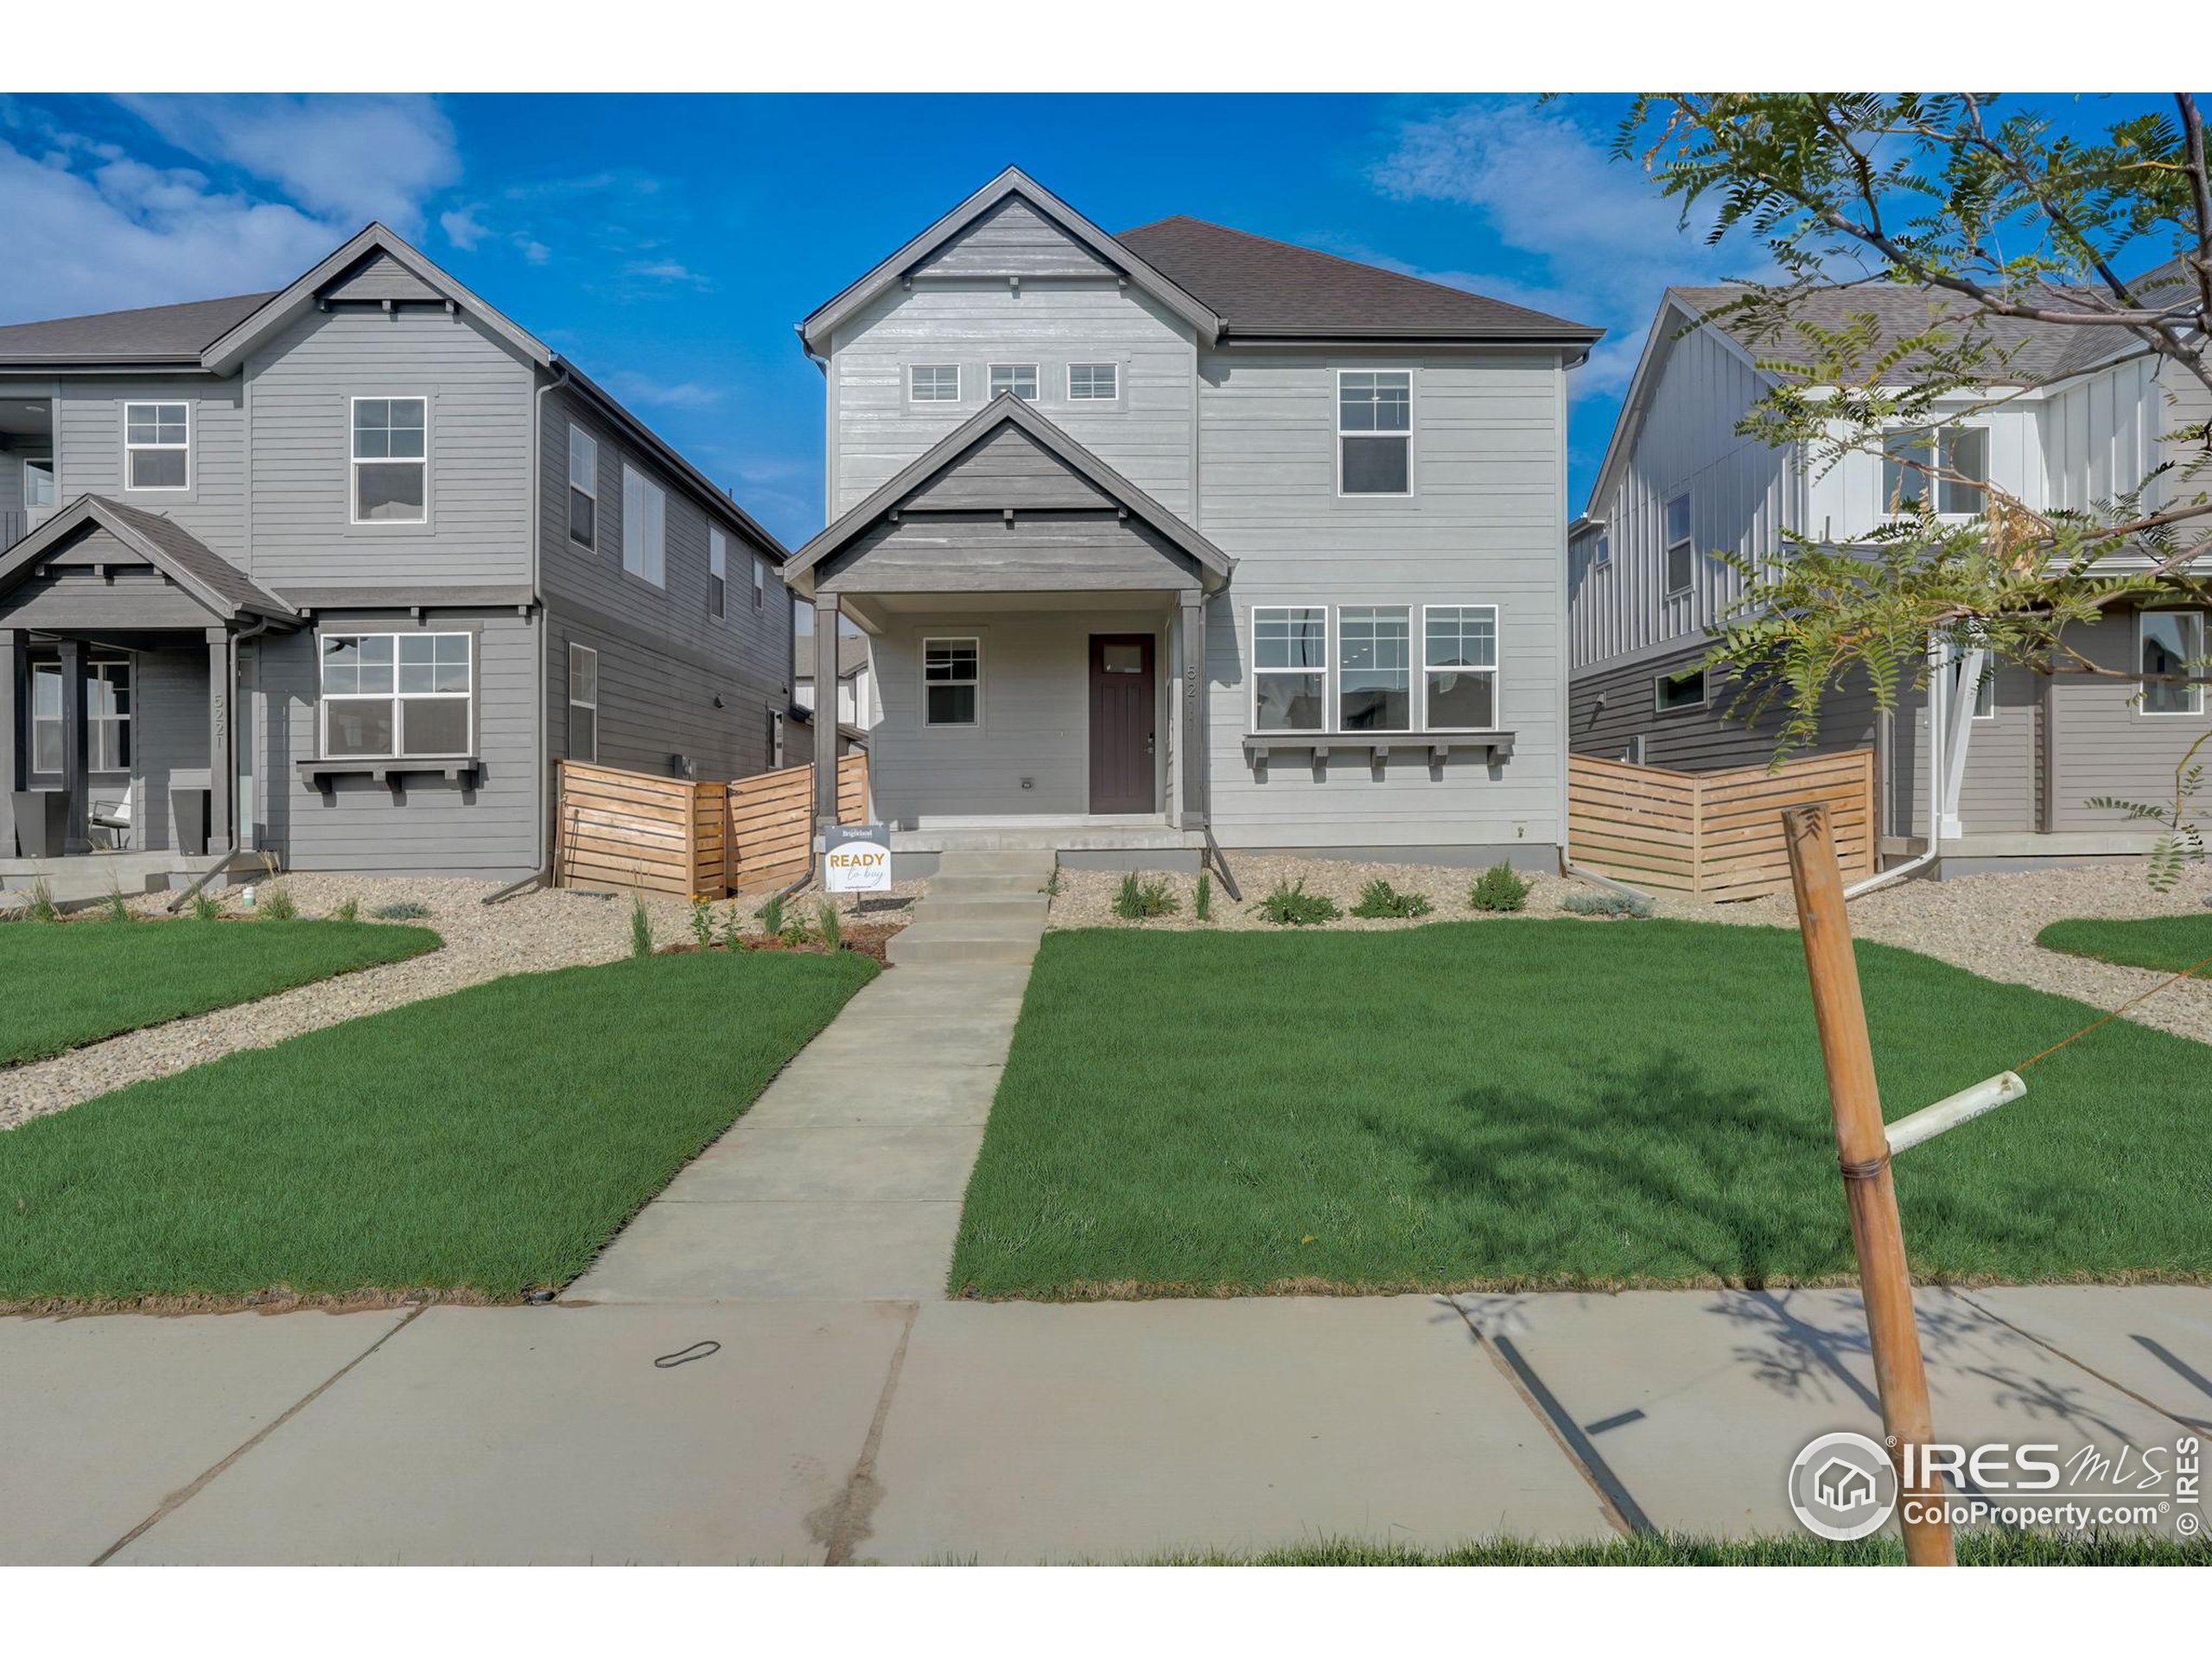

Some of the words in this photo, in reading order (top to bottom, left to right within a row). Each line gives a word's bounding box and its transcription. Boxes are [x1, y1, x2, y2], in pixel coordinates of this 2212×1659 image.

[213, 695, 224, 749] 5221
[830, 853, 885, 868] READY
[848, 866, 862, 880] to
[864, 867, 884, 886] buy
